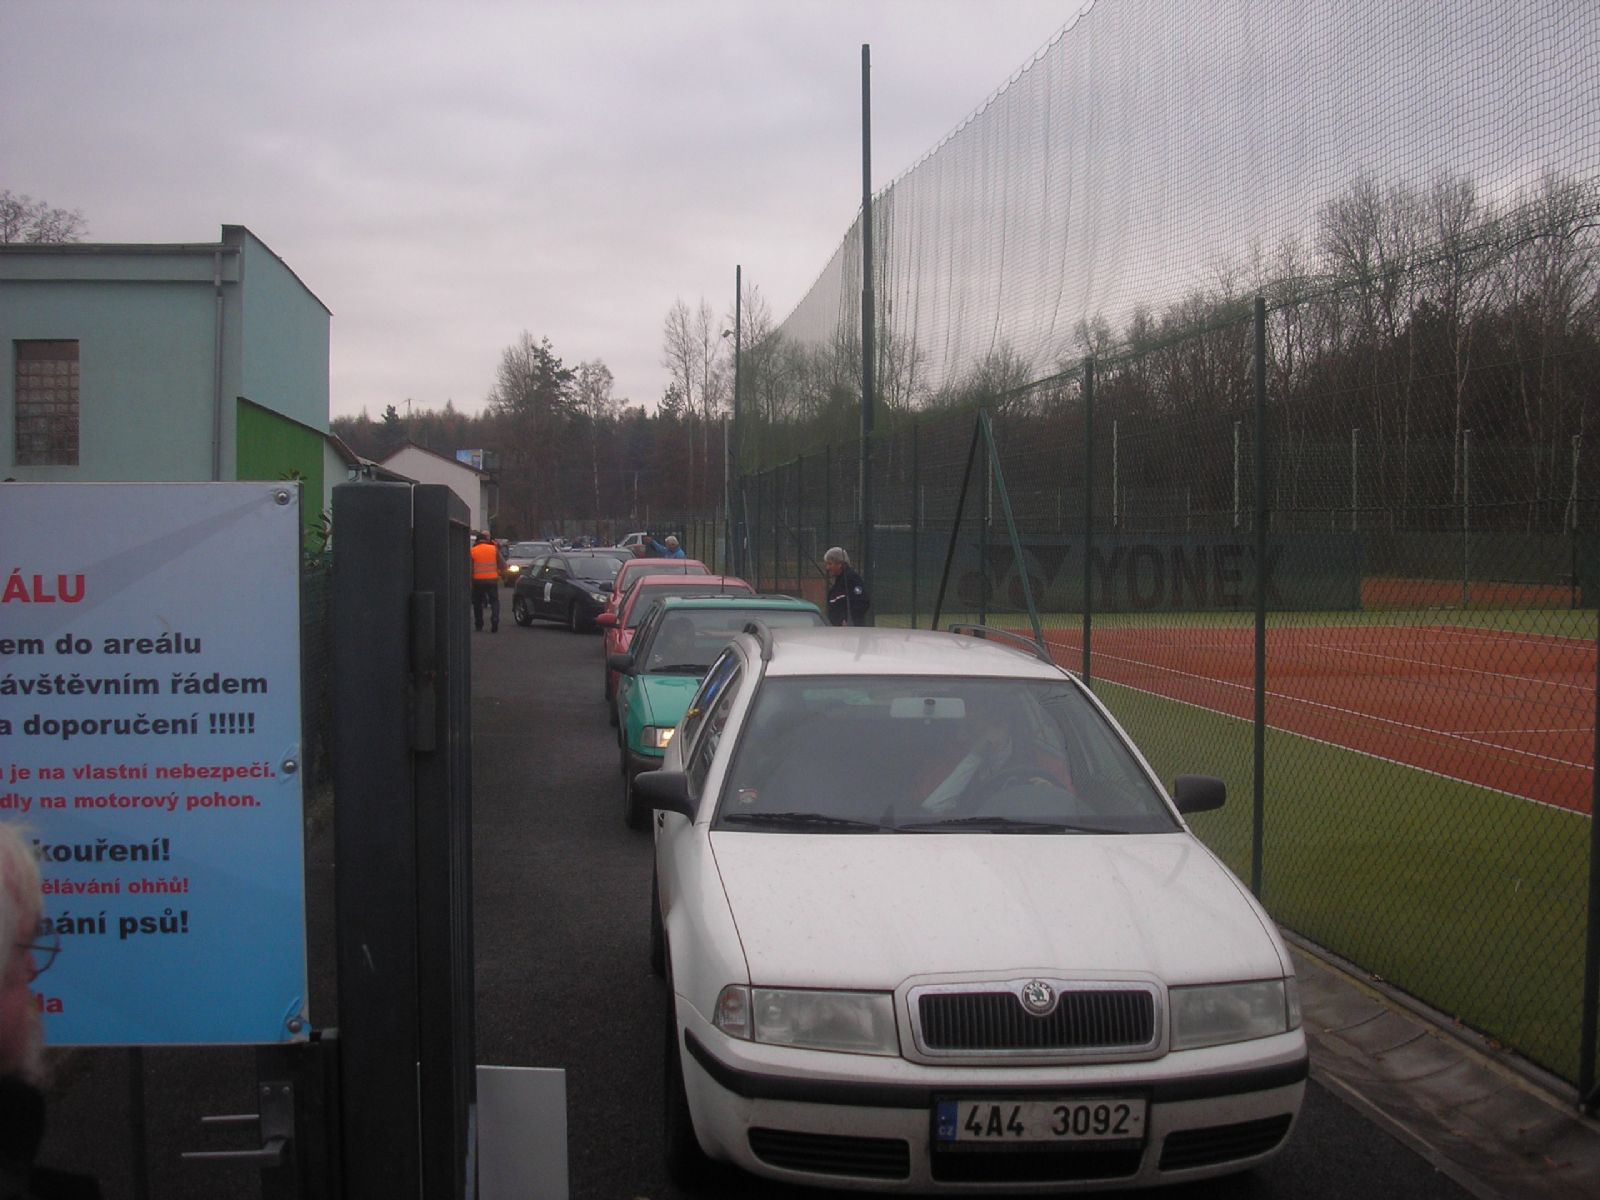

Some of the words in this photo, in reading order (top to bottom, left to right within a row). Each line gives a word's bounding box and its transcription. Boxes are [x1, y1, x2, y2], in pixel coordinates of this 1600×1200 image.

[2, 568, 86, 603] ÁLU
[1090, 544, 1282, 607] YONEX
[0, 638, 44, 655] em
[56, 634, 92, 655] do
[104, 632, 201, 655] areálu
[0, 673, 159, 695] ávštěvním
[171, 673, 268, 695] řádem
[24, 713, 198, 740] doporučení
[10, 763, 31, 784] je
[39, 767, 65, 780] na
[73, 763, 147, 780] vlastní
[156, 762, 276, 782] nebezpečí.
[0, 794, 32, 813] dly
[40, 796, 66, 809] na
[75, 792, 178, 811] motorový
[187, 792, 261, 811] pohon.
[33, 838, 170, 862] kouření!
[42, 878, 120, 895] ělávání
[128, 877, 189, 894] ohňů!
[120, 908, 189, 939] psů!
[938, 1126, 954, 1137] CZ
[964, 1104, 1025, 1137] 4A4
[1052, 1104, 1131, 1136] 3092
